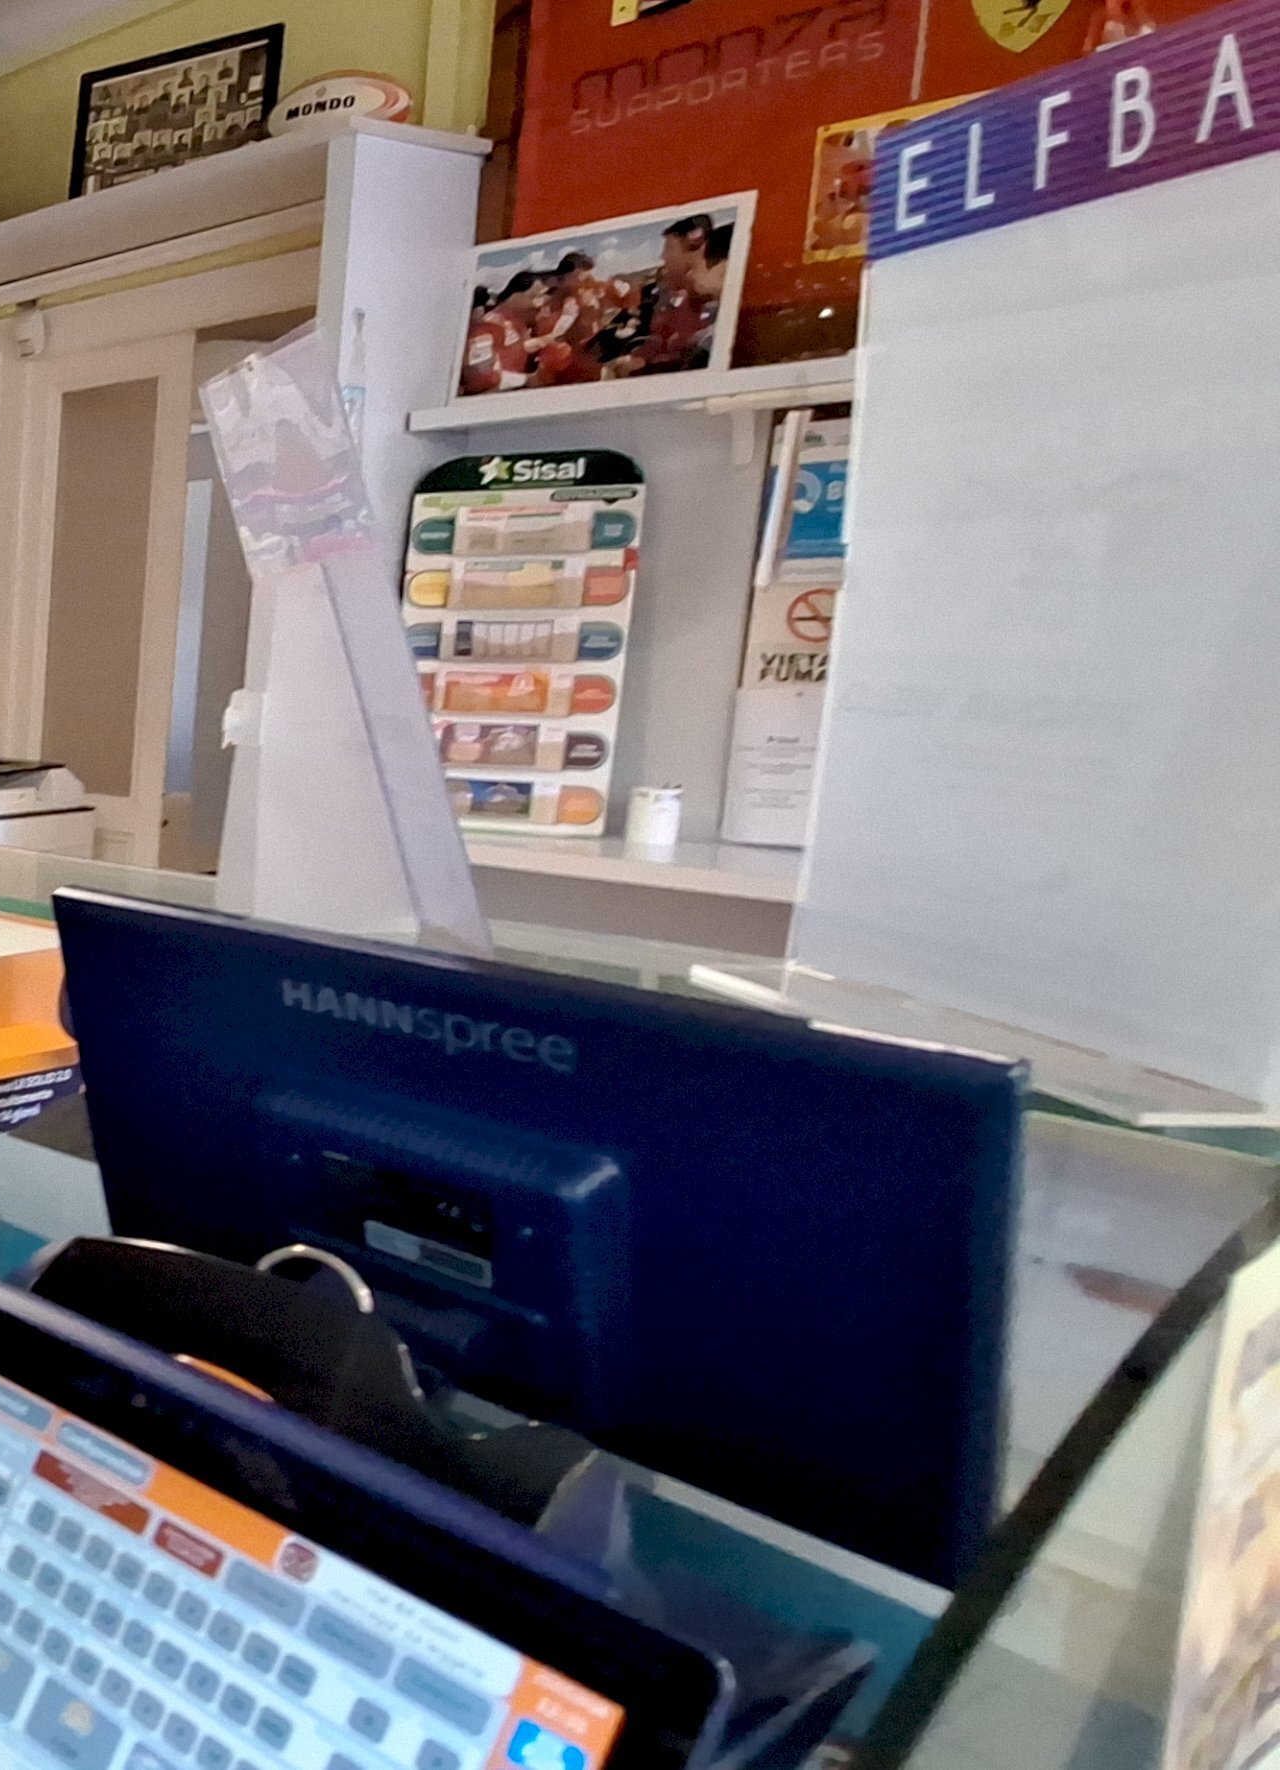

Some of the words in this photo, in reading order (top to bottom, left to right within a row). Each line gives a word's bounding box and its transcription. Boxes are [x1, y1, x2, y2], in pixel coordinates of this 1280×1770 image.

[285, 95, 355, 121] MONDO
[571, 30, 886, 135] SUPPORTERS
[513, 457, 587, 482] Sisal
[281, 978, 577, 1074] HANNspree
